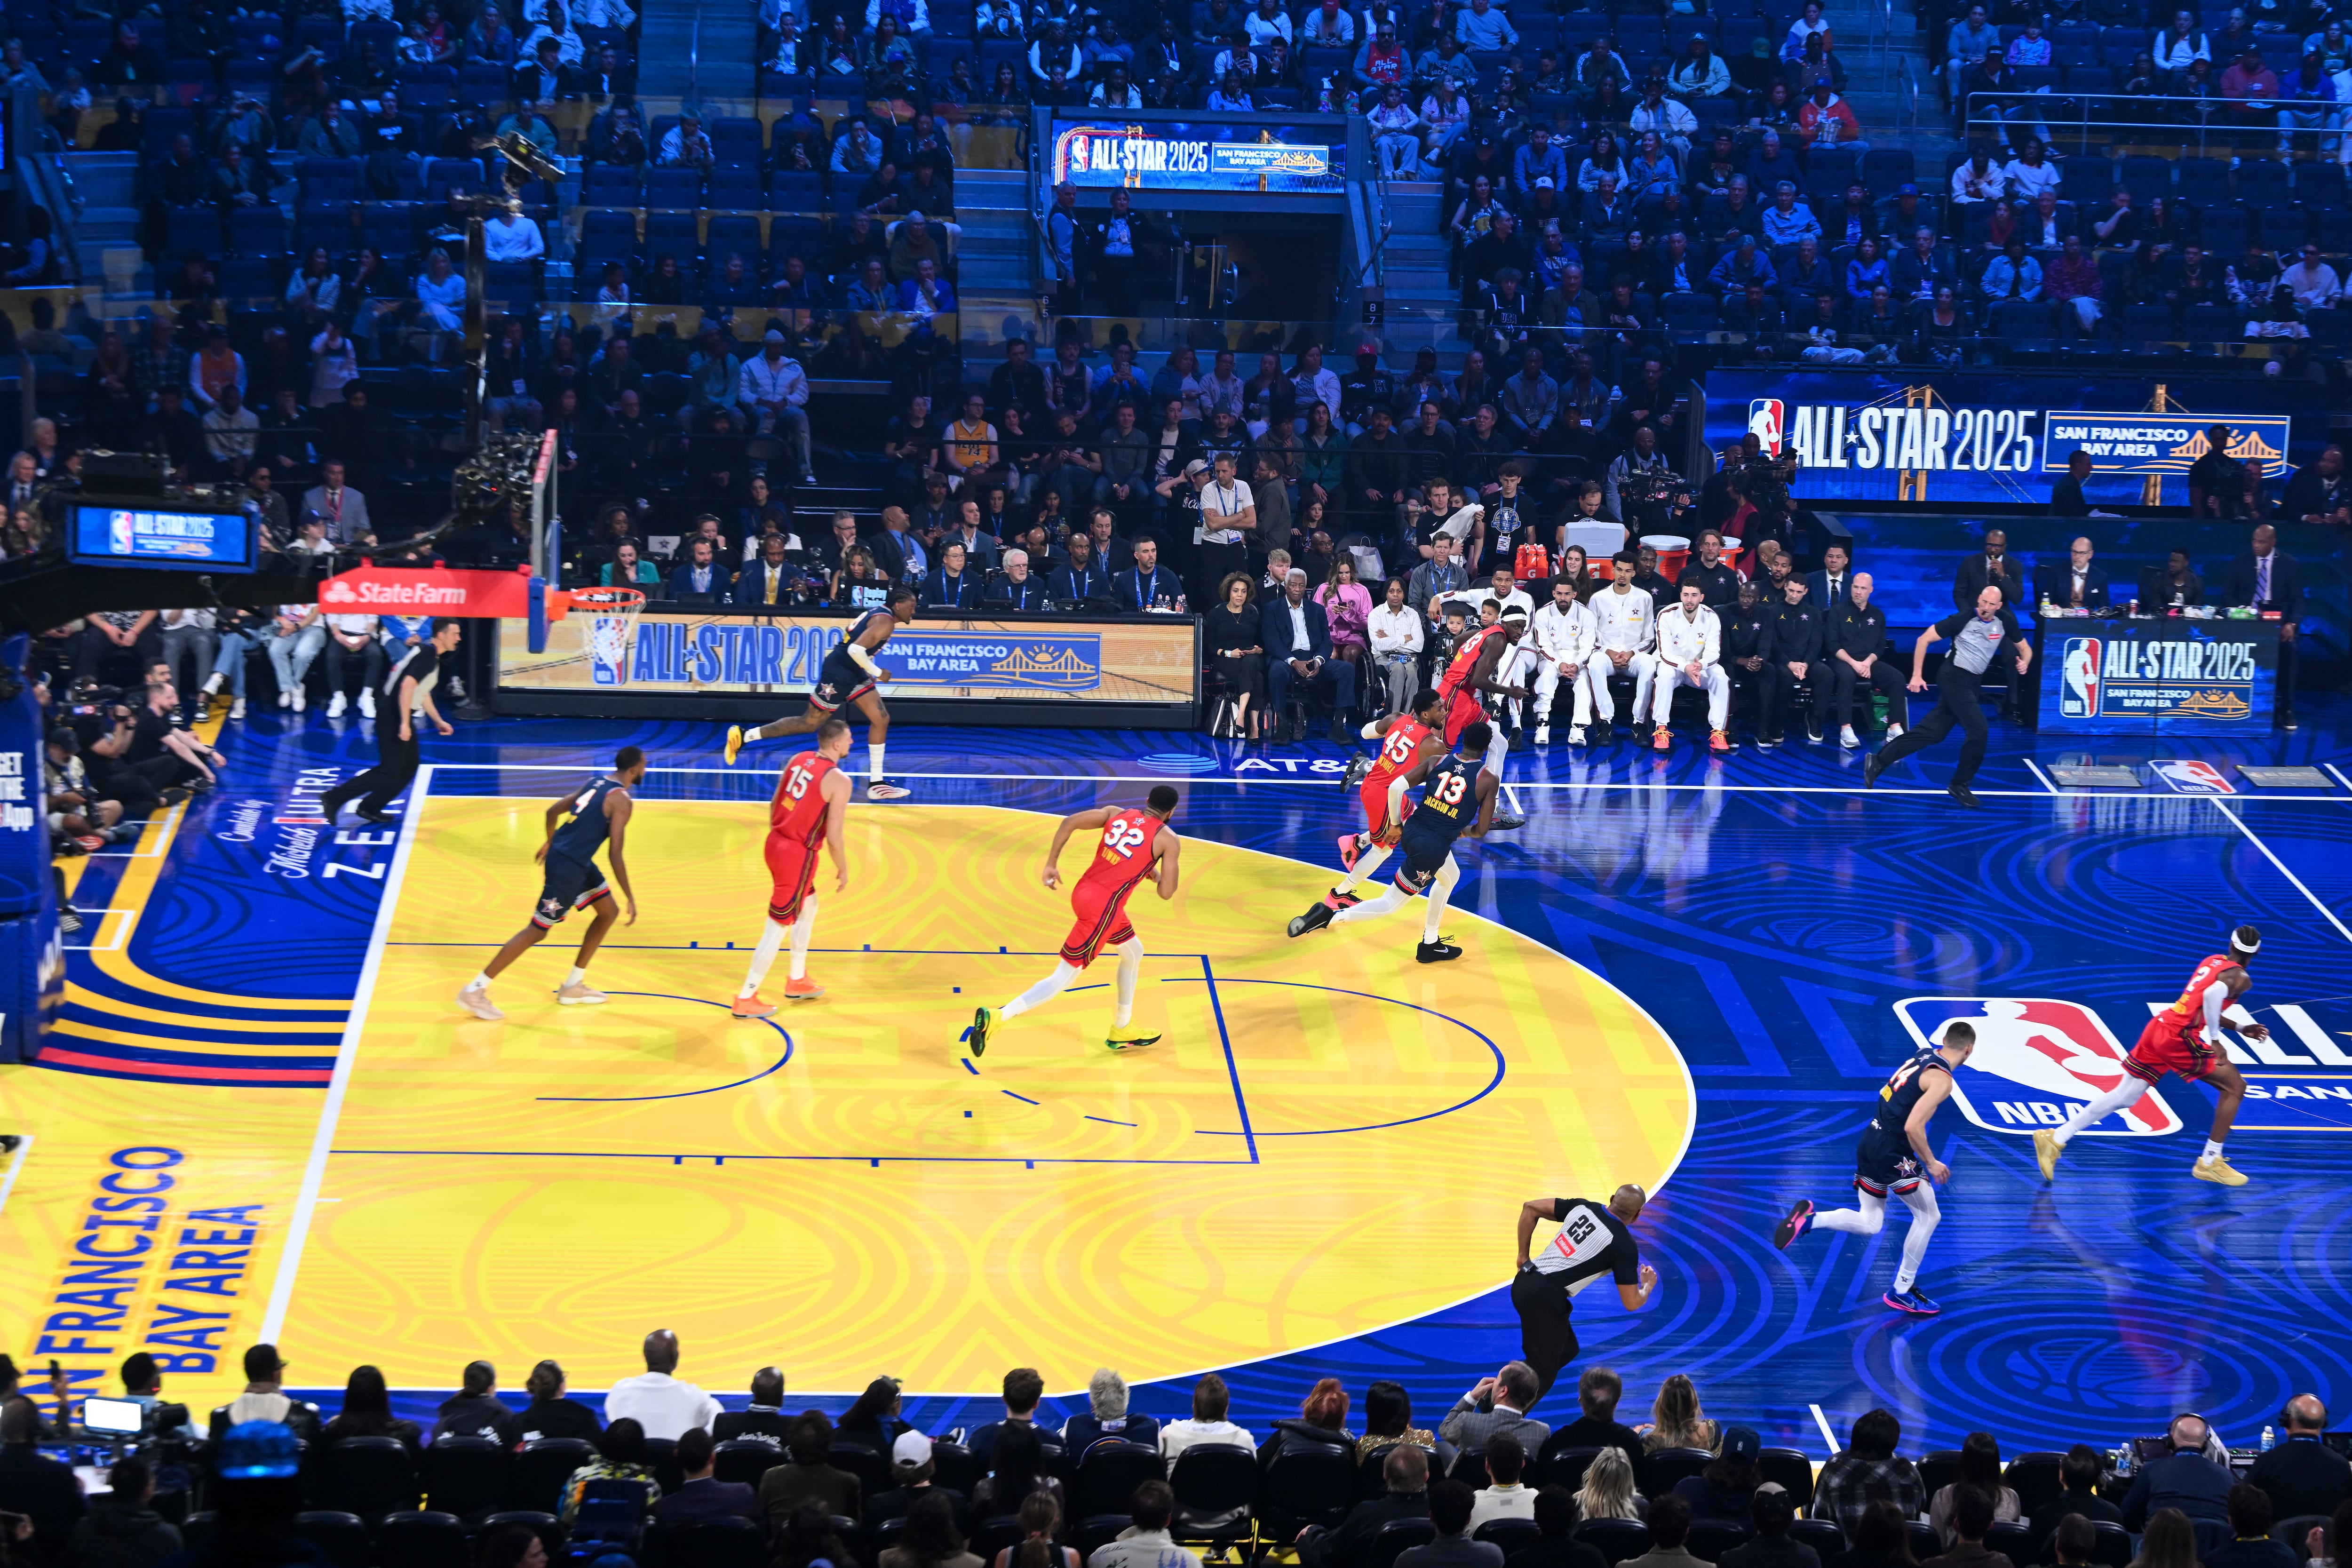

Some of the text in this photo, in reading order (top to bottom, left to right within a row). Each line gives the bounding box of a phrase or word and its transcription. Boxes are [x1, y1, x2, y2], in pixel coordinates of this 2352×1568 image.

[1371, 64, 1398, 74] STAR
[1092, 139, 1208, 172] ALL STAR 2025
[1216, 150, 1281, 159] SAN FRANCISCO
[1042, 295, 1049, 305] 6
[1369, 303, 1376, 312] 8
[1042, 309, 1049, 318] 5
[1369, 316, 1376, 325] 7
[1501, 312, 1518, 324] USA
[1791, 405, 2038, 472] ALL STAR 2025
[2054, 426, 2189, 442] SAN FRANCISCO
[2081, 443, 2158, 457] BAY AREA
[1527, 569, 1536, 578] G
[632, 622, 691, 683] ALL
[696, 623, 784, 685] STAR
[882, 644, 1007, 658] SAN FRANCISCO
[908, 659, 979, 671] BAY AREA
[2103, 640, 2257, 681] ALL STAR 2025
[2106, 688, 2192, 699] SAN FRANCISCO
[2064, 700, 2082, 713] NBA
[2122, 698, 2172, 708] BAY AREA
[1384, 730, 1416, 765] 45
[1234, 758, 1376, 773] AT&
[785, 765, 814, 801] 15
[1434, 771, 1467, 805] 13
[575, 788, 597, 814] 4
[1423, 795, 1459, 819] JACKSON JR.
[1104, 819, 1144, 860] 32
[262, 826, 319, 879] Michelob
[2185, 966, 2211, 992] 2
[1890, 1058, 1920, 1092] 14
[2243, 1085, 2352, 1099] SAN
[1566, 1214, 1597, 1245] 23
[33, 1146, 185, 1355] FRANCISCO
[1557, 1236, 1572, 1255] Emirates
[145, 1204, 265, 1374] BAY AREA
